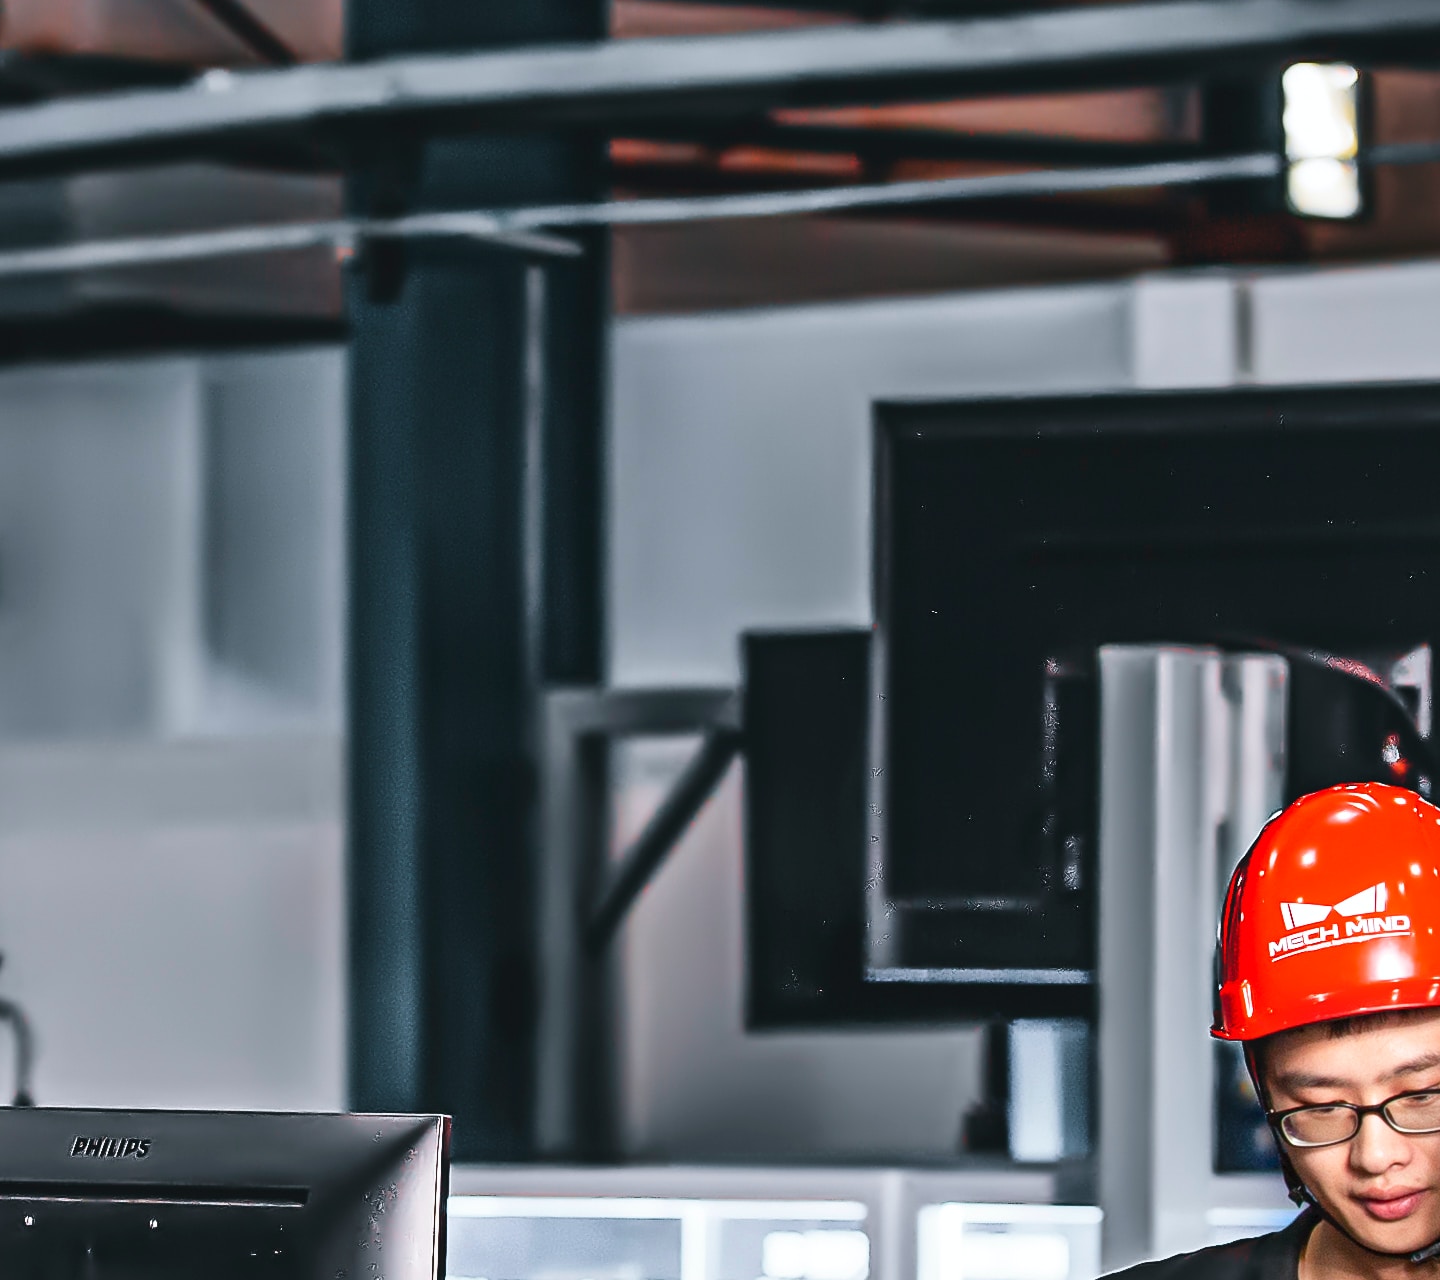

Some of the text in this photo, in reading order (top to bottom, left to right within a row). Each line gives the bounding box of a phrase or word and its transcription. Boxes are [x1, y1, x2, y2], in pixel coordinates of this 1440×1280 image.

[1268, 915, 1411, 957] MECH MIND
[70, 1135, 153, 1160] PHILIPS
